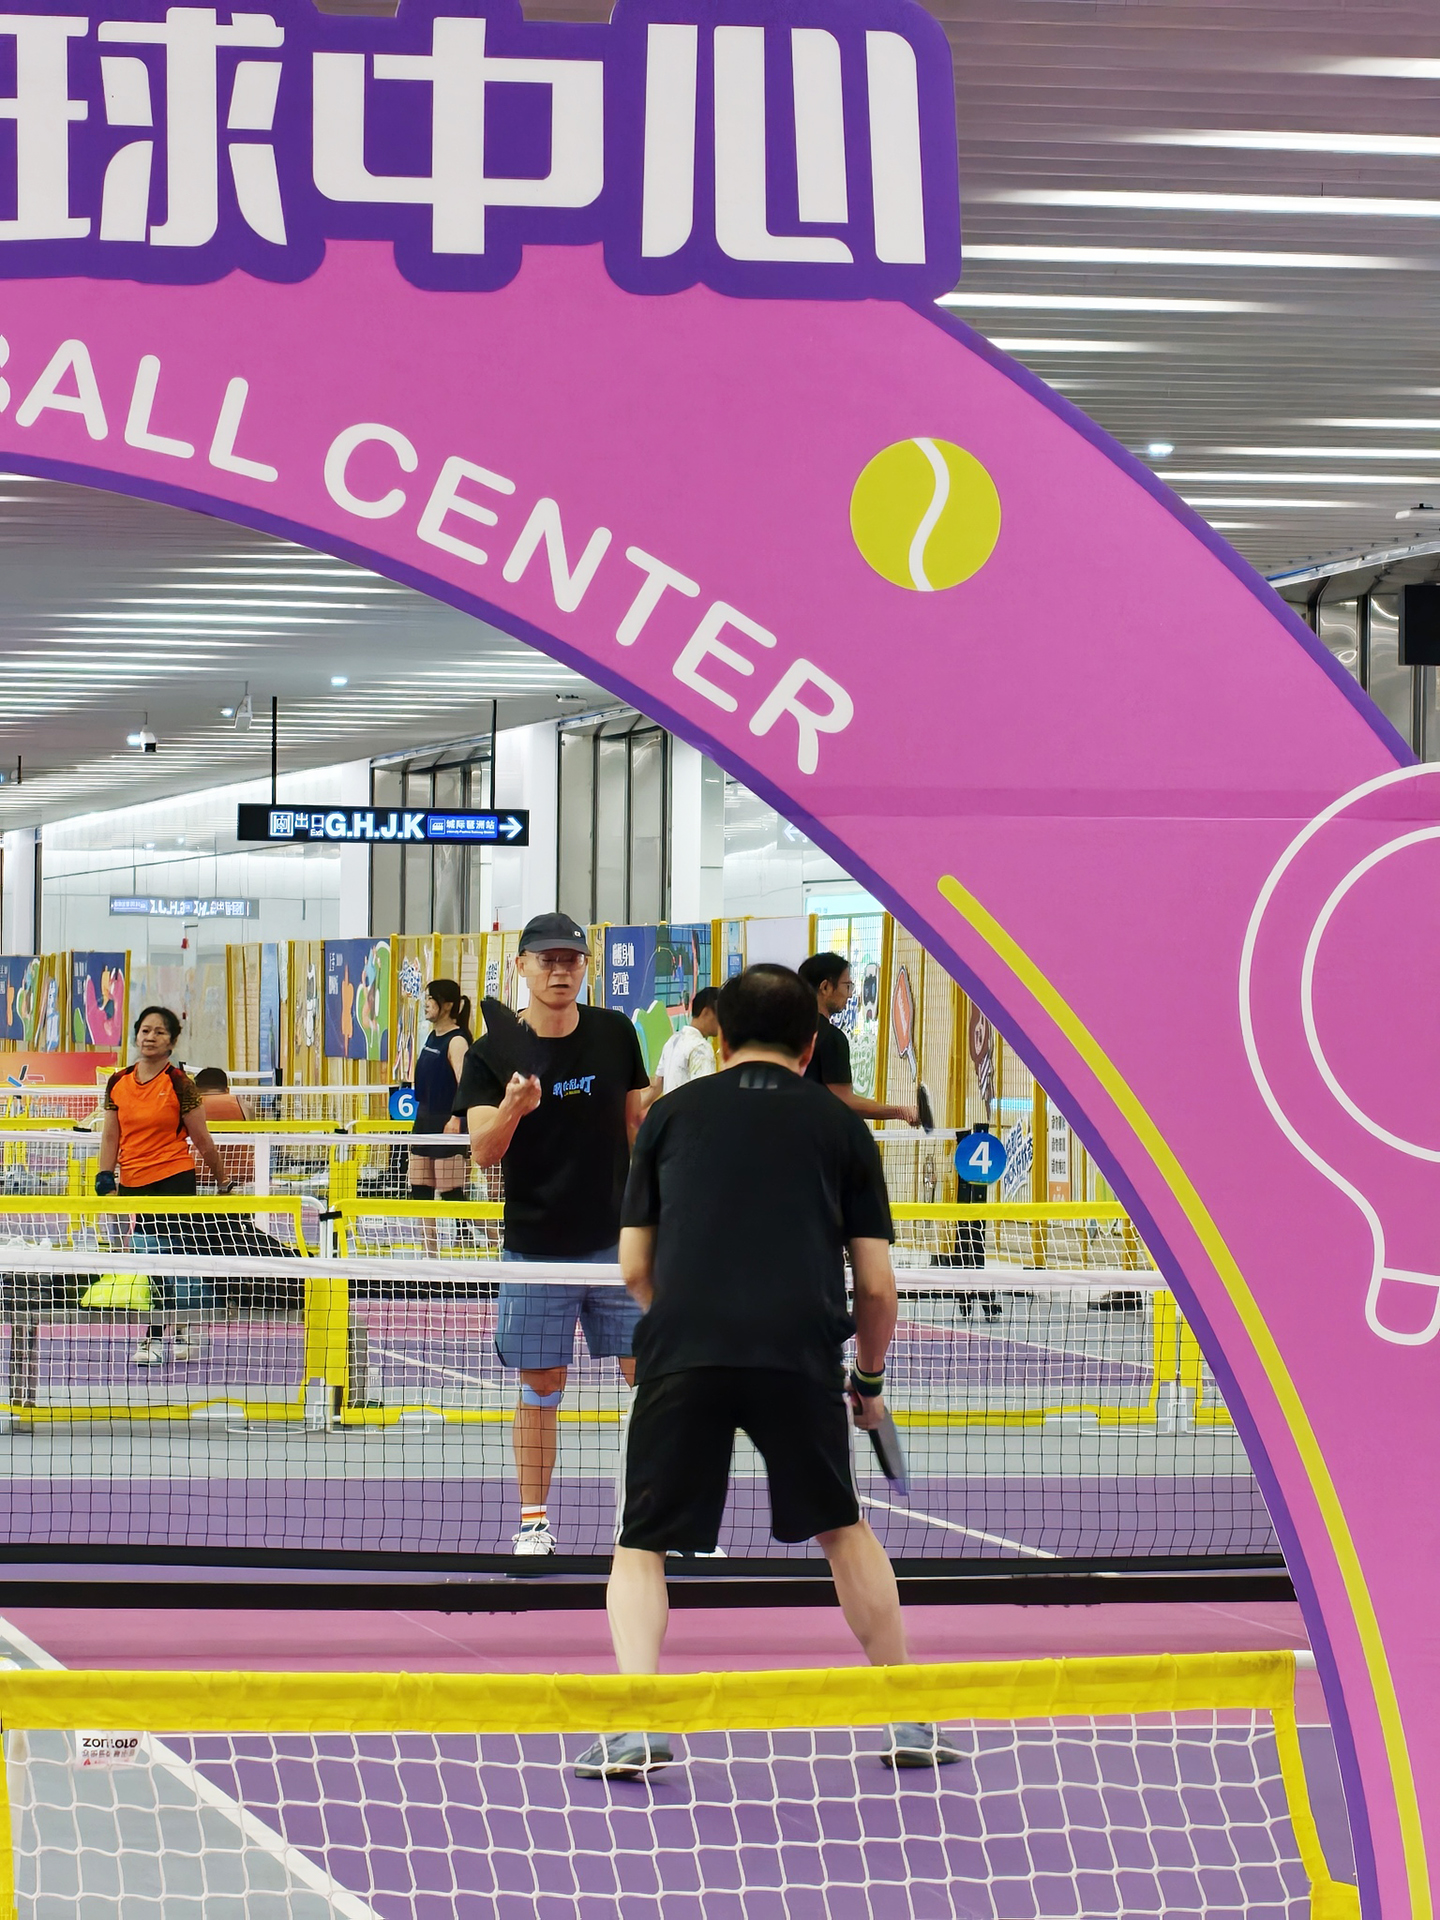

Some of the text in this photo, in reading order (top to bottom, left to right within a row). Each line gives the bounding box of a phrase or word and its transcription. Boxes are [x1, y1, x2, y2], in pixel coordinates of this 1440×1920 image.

[0, 8, 925, 263] 球中心
[0, 334, 853, 774] ALL CENTER
[295, 812, 425, 840] 出口 G.H.J.K
[398, 1094, 414, 1118] 6
[969, 1141, 992, 1175] 4
